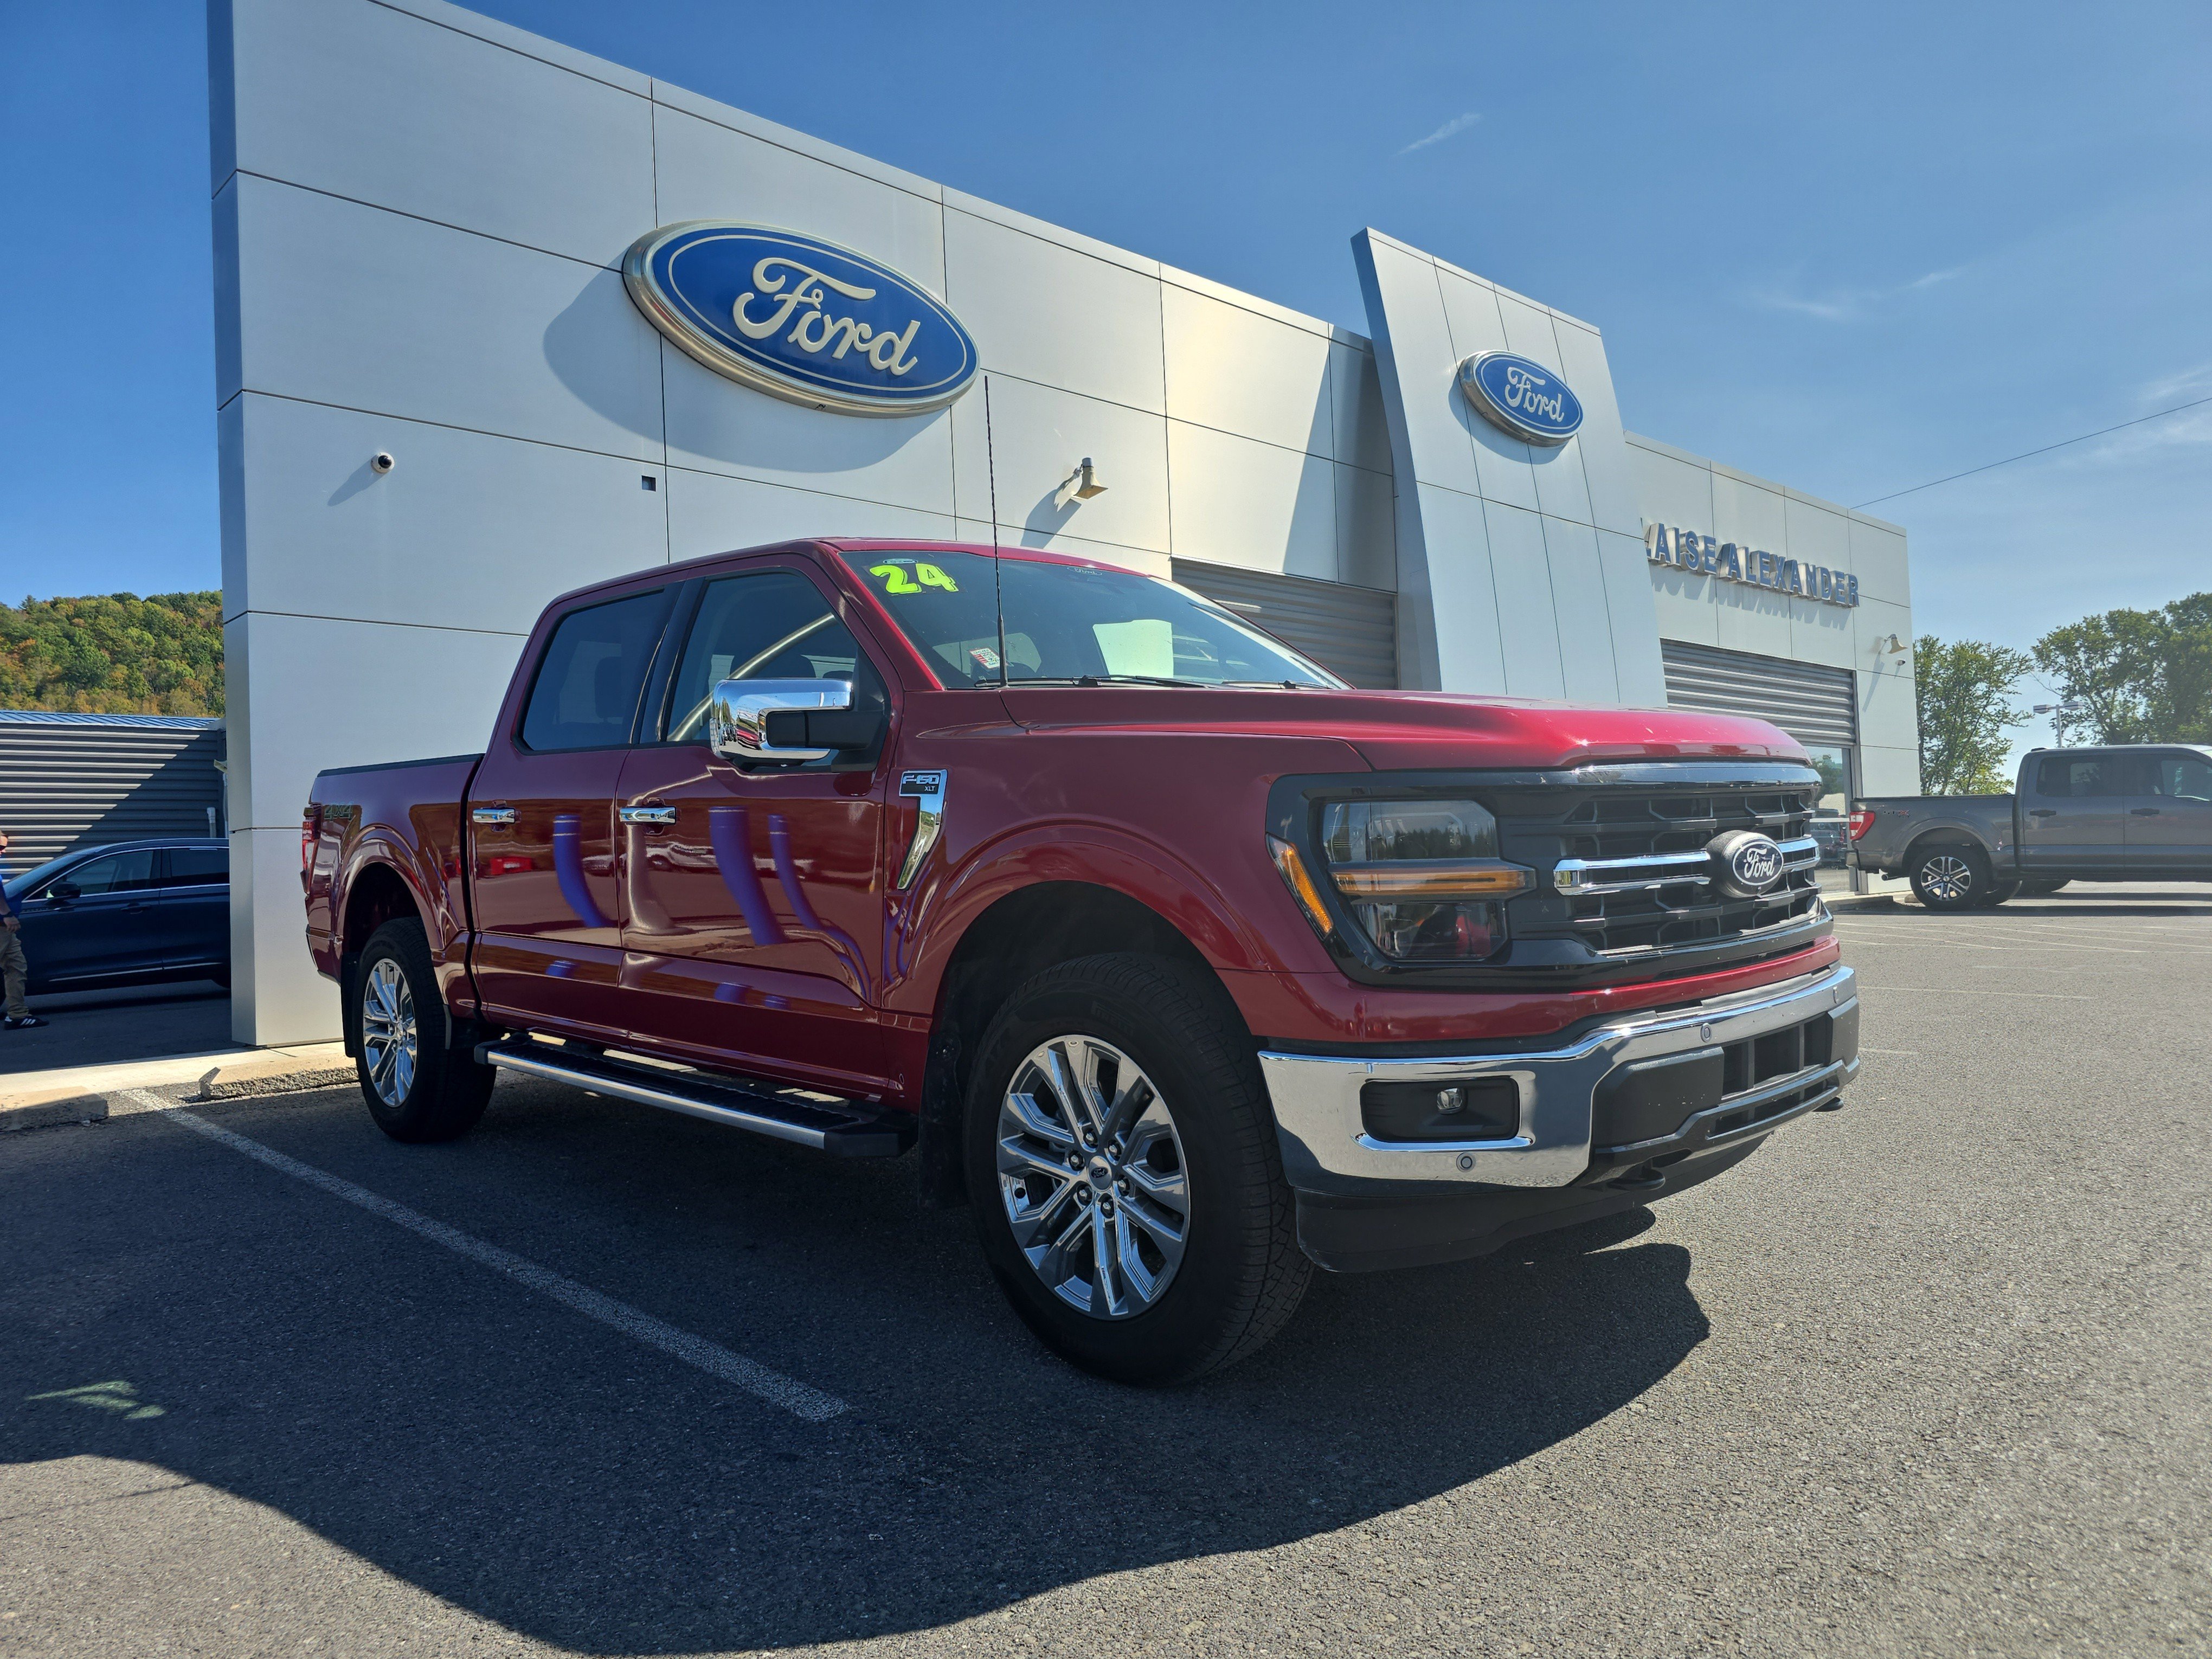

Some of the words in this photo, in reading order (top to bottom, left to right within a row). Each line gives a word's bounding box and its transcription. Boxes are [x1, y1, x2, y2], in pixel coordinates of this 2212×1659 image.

[732, 257, 921, 376] Ford
[1504, 366, 1564, 422] Ford
[870, 563, 959, 594] 24
[1645, 523, 1717, 575] AISE
[1719, 542, 1860, 607] ALEXANDER
[902, 774, 940, 785] F-150
[1744, 847, 1775, 879] Ford
[1093, 1168, 1105, 1177] Ford
